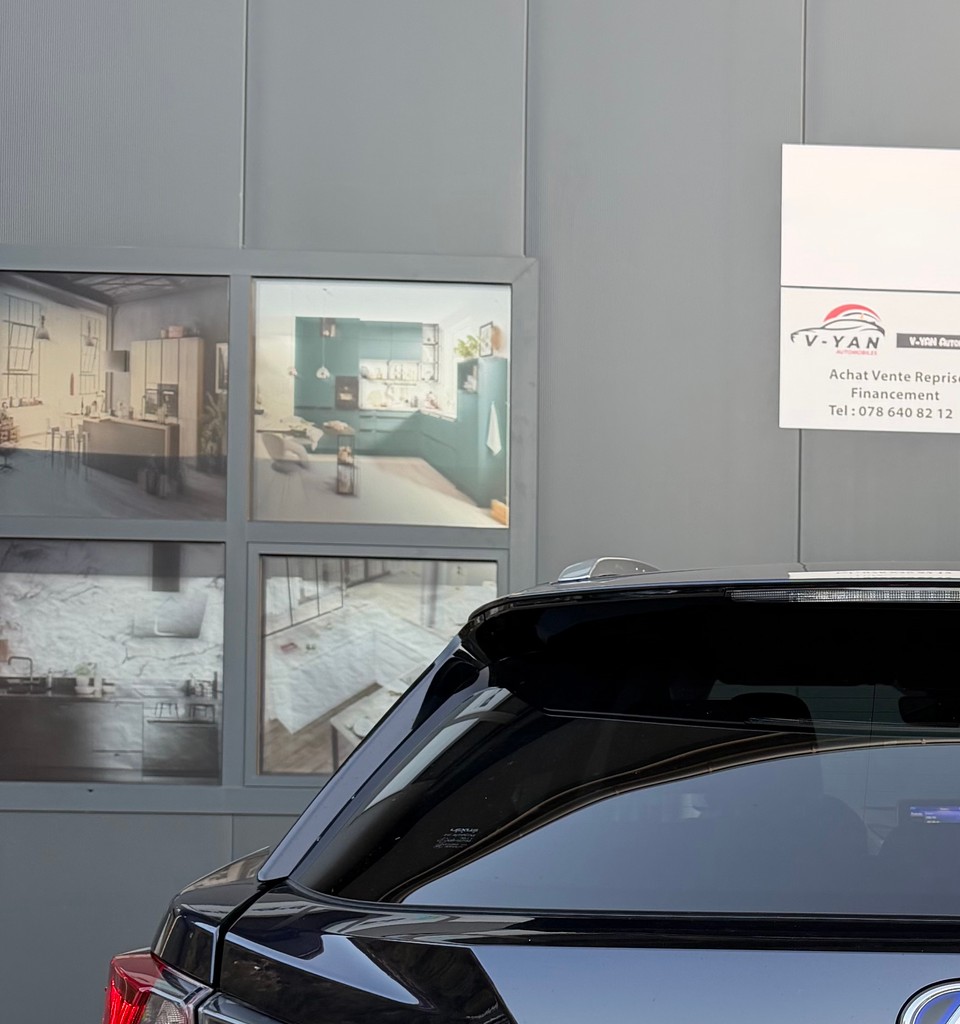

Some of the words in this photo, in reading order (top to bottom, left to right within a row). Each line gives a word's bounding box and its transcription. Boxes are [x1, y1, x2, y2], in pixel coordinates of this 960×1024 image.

[805, 334, 880, 349] V-YAN
[829, 368, 868, 382] Achat
[872, 370, 911, 383] Vente
[851, 387, 940, 401] Financement
[829, 405, 848, 416] Tel
[858, 406, 884, 417] 078
[888, 407, 912, 418] 640
[916, 408, 933, 419] 82
[938, 408, 953, 420] 12
